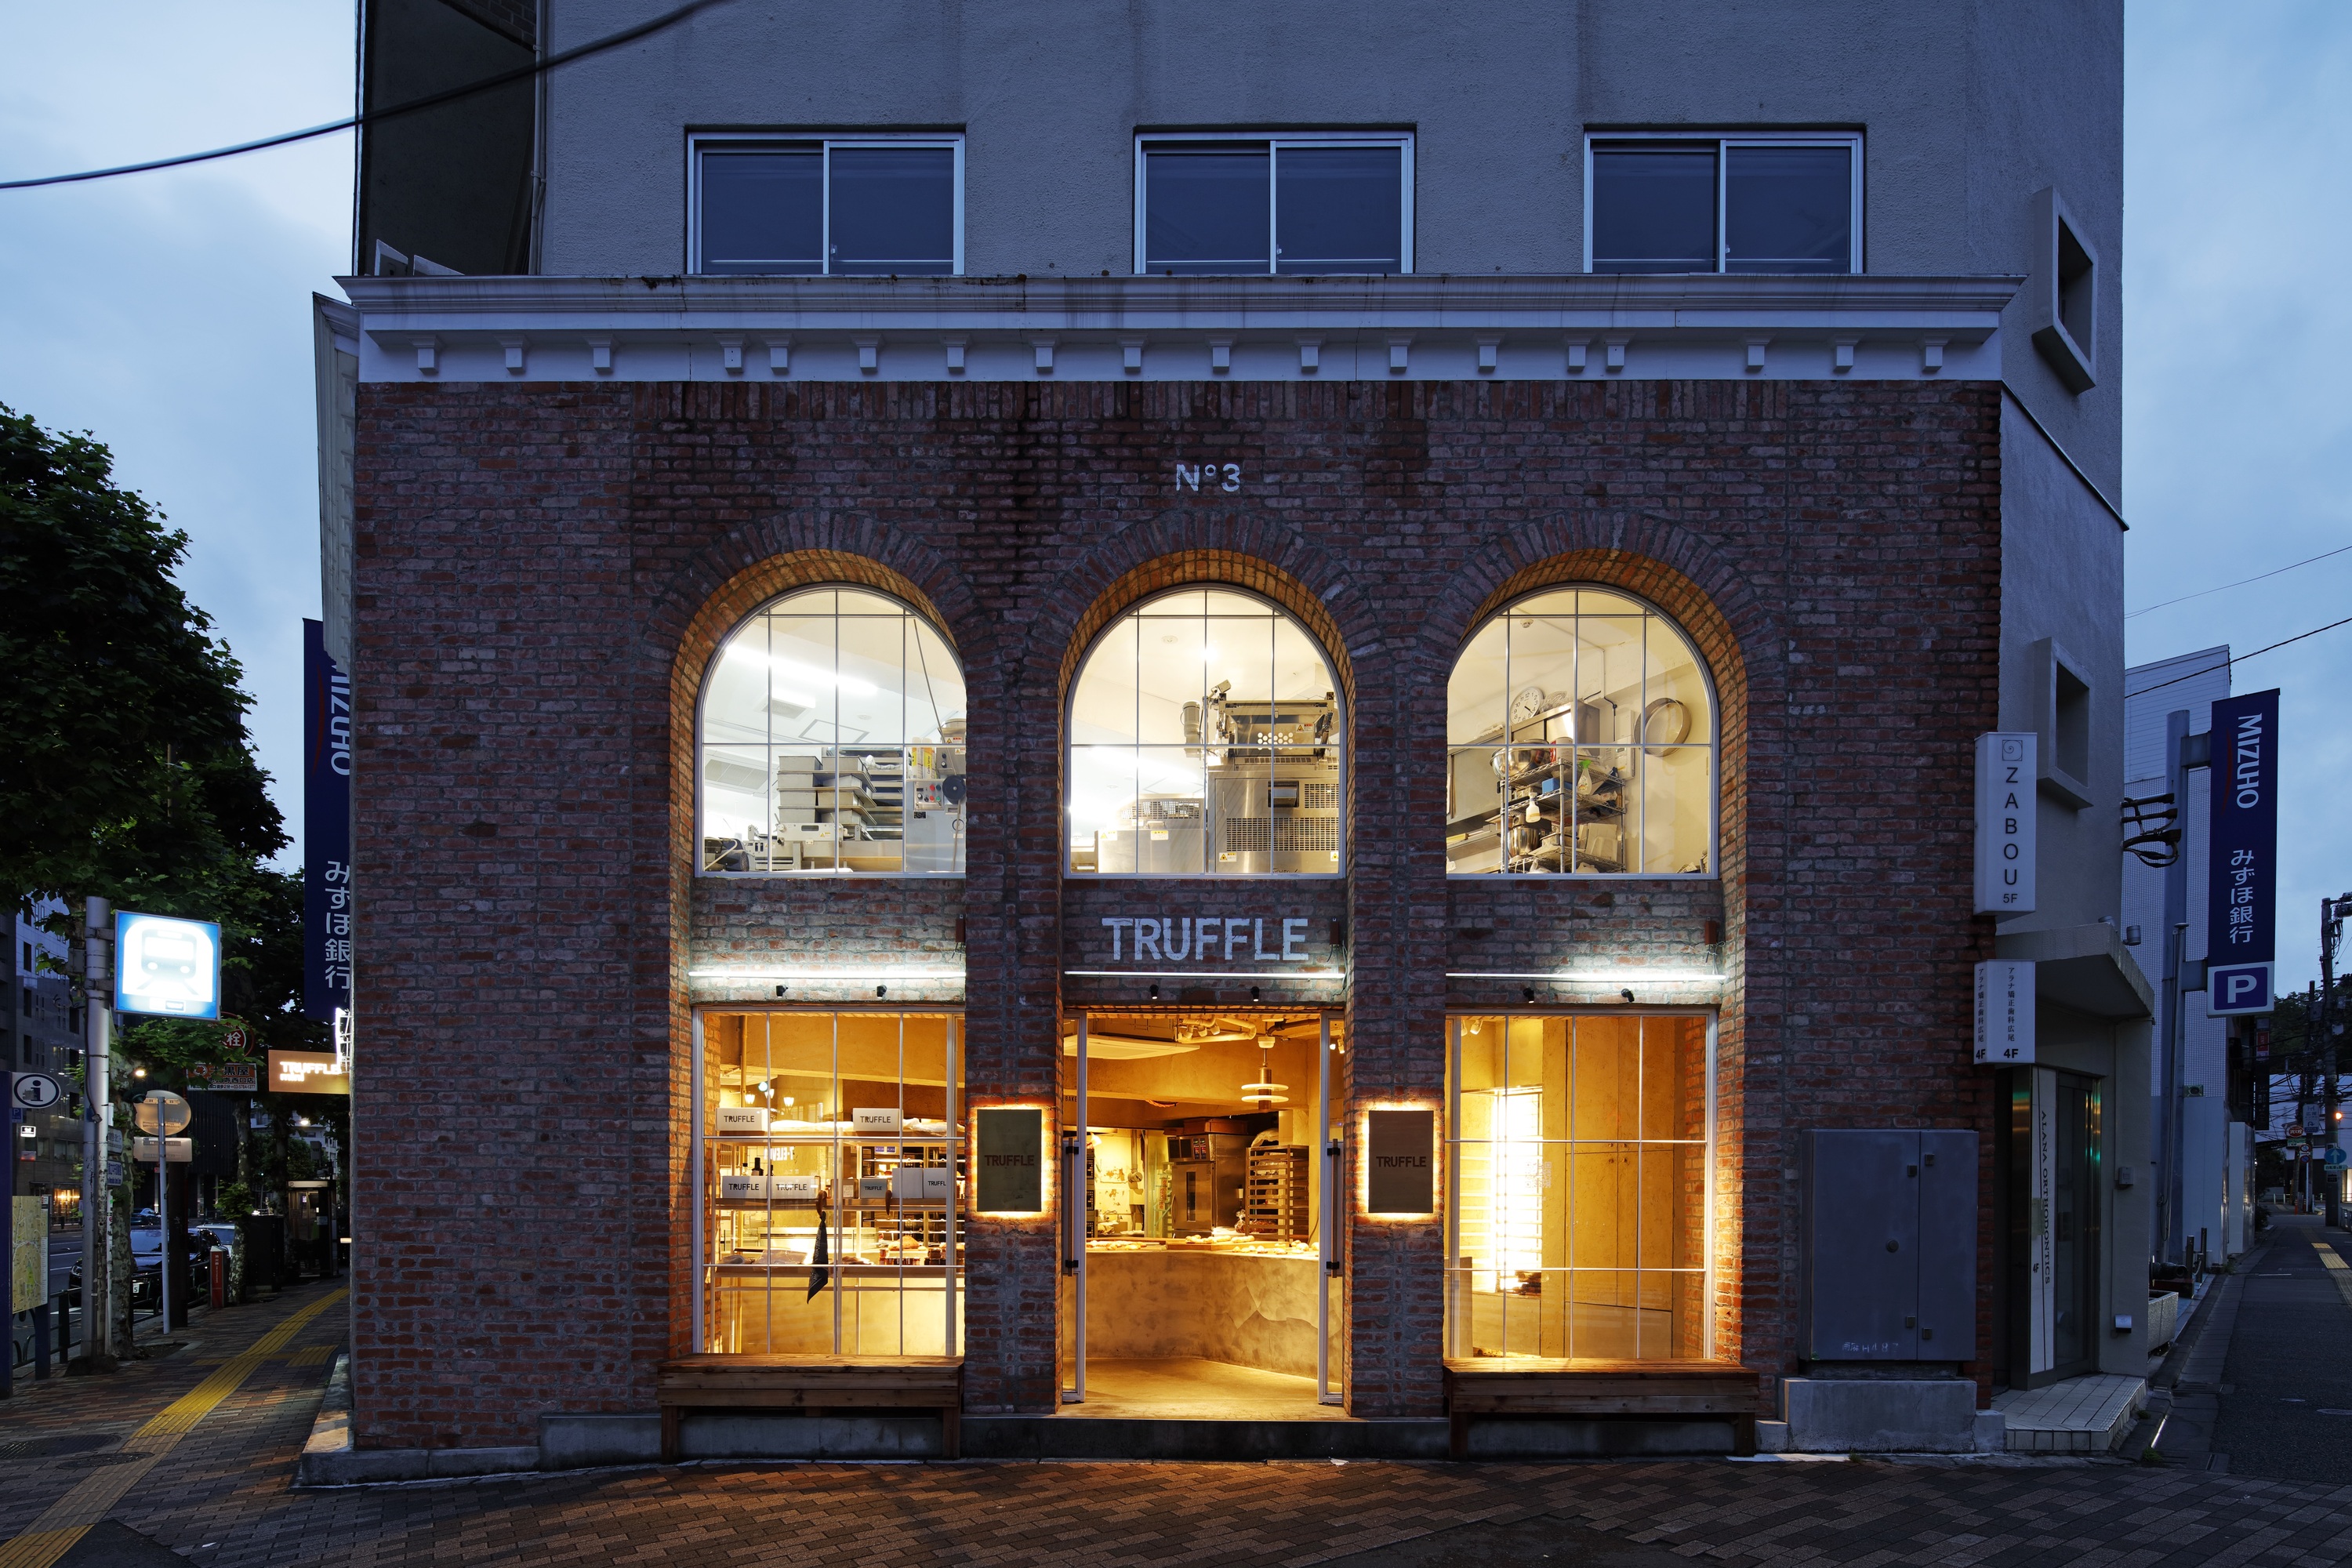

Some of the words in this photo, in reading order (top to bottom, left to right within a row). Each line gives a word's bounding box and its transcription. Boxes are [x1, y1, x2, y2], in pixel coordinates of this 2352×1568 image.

[2236, 712, 2263, 809] MIZUHO
[2003, 767, 2019, 885] ZABOU
[2003, 893, 2018, 903] 5F
[2229, 848, 2256, 945] みずほ銀行
[325, 860, 350, 989] みずほ銀行
[1102, 917, 1309, 961] TRUFFLE
[2227, 974, 2257, 1004] P
[1976, 1048, 1986, 1059] 4F
[2003, 1048, 2019, 1058] 4F
[984, 1155, 1035, 1167] TRUFFLE
[1376, 1156, 1427, 1167] TRUFFLE
[2032, 1262, 2039, 1273] 4F
